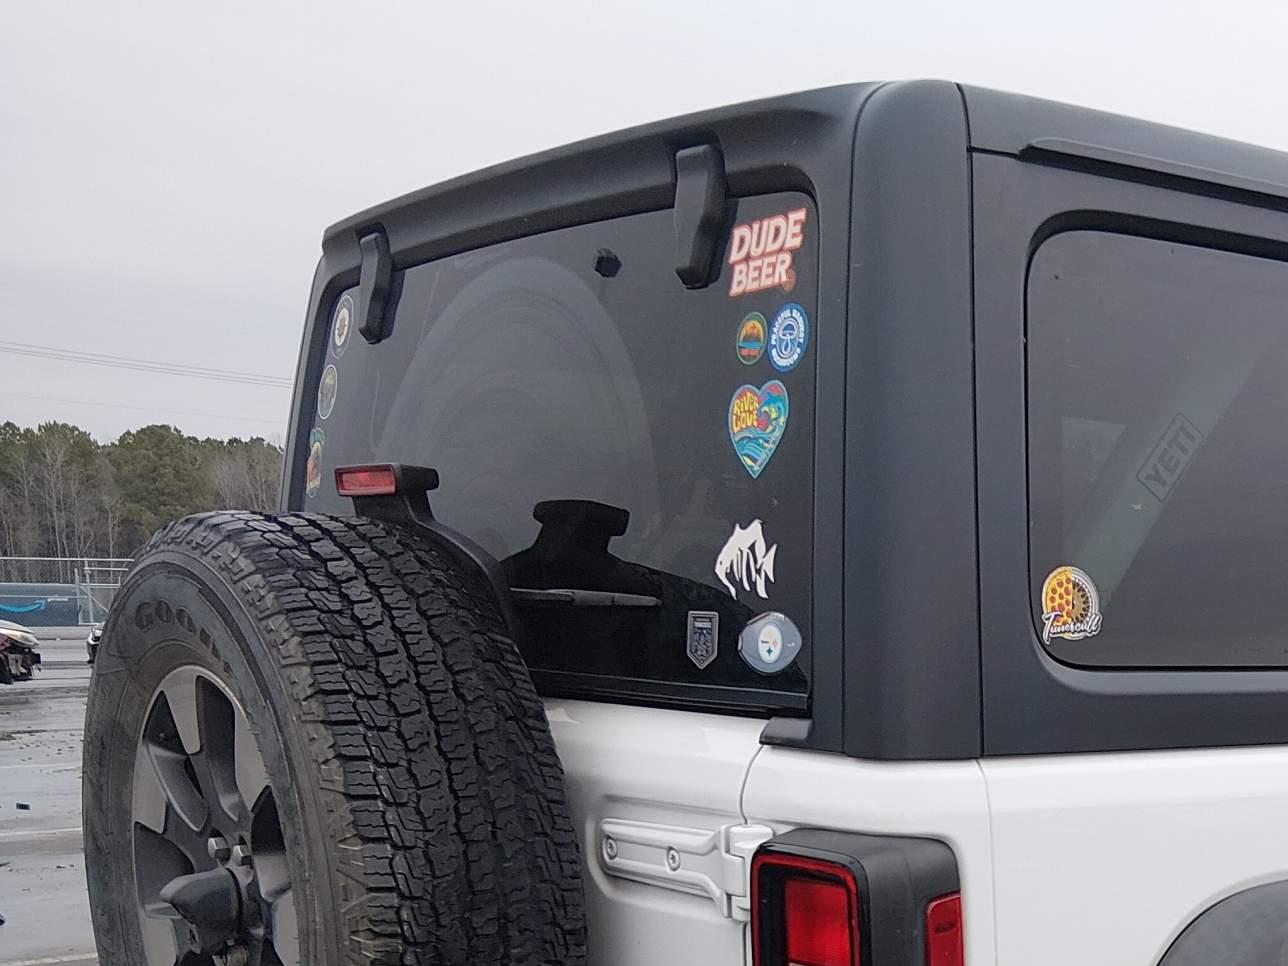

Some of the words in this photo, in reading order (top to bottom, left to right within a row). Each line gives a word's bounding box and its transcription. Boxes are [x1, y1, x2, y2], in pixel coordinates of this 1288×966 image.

[729, 208, 807, 264] DUDE
[729, 252, 792, 296] BEER
[1143, 425, 1197, 488] YETI
